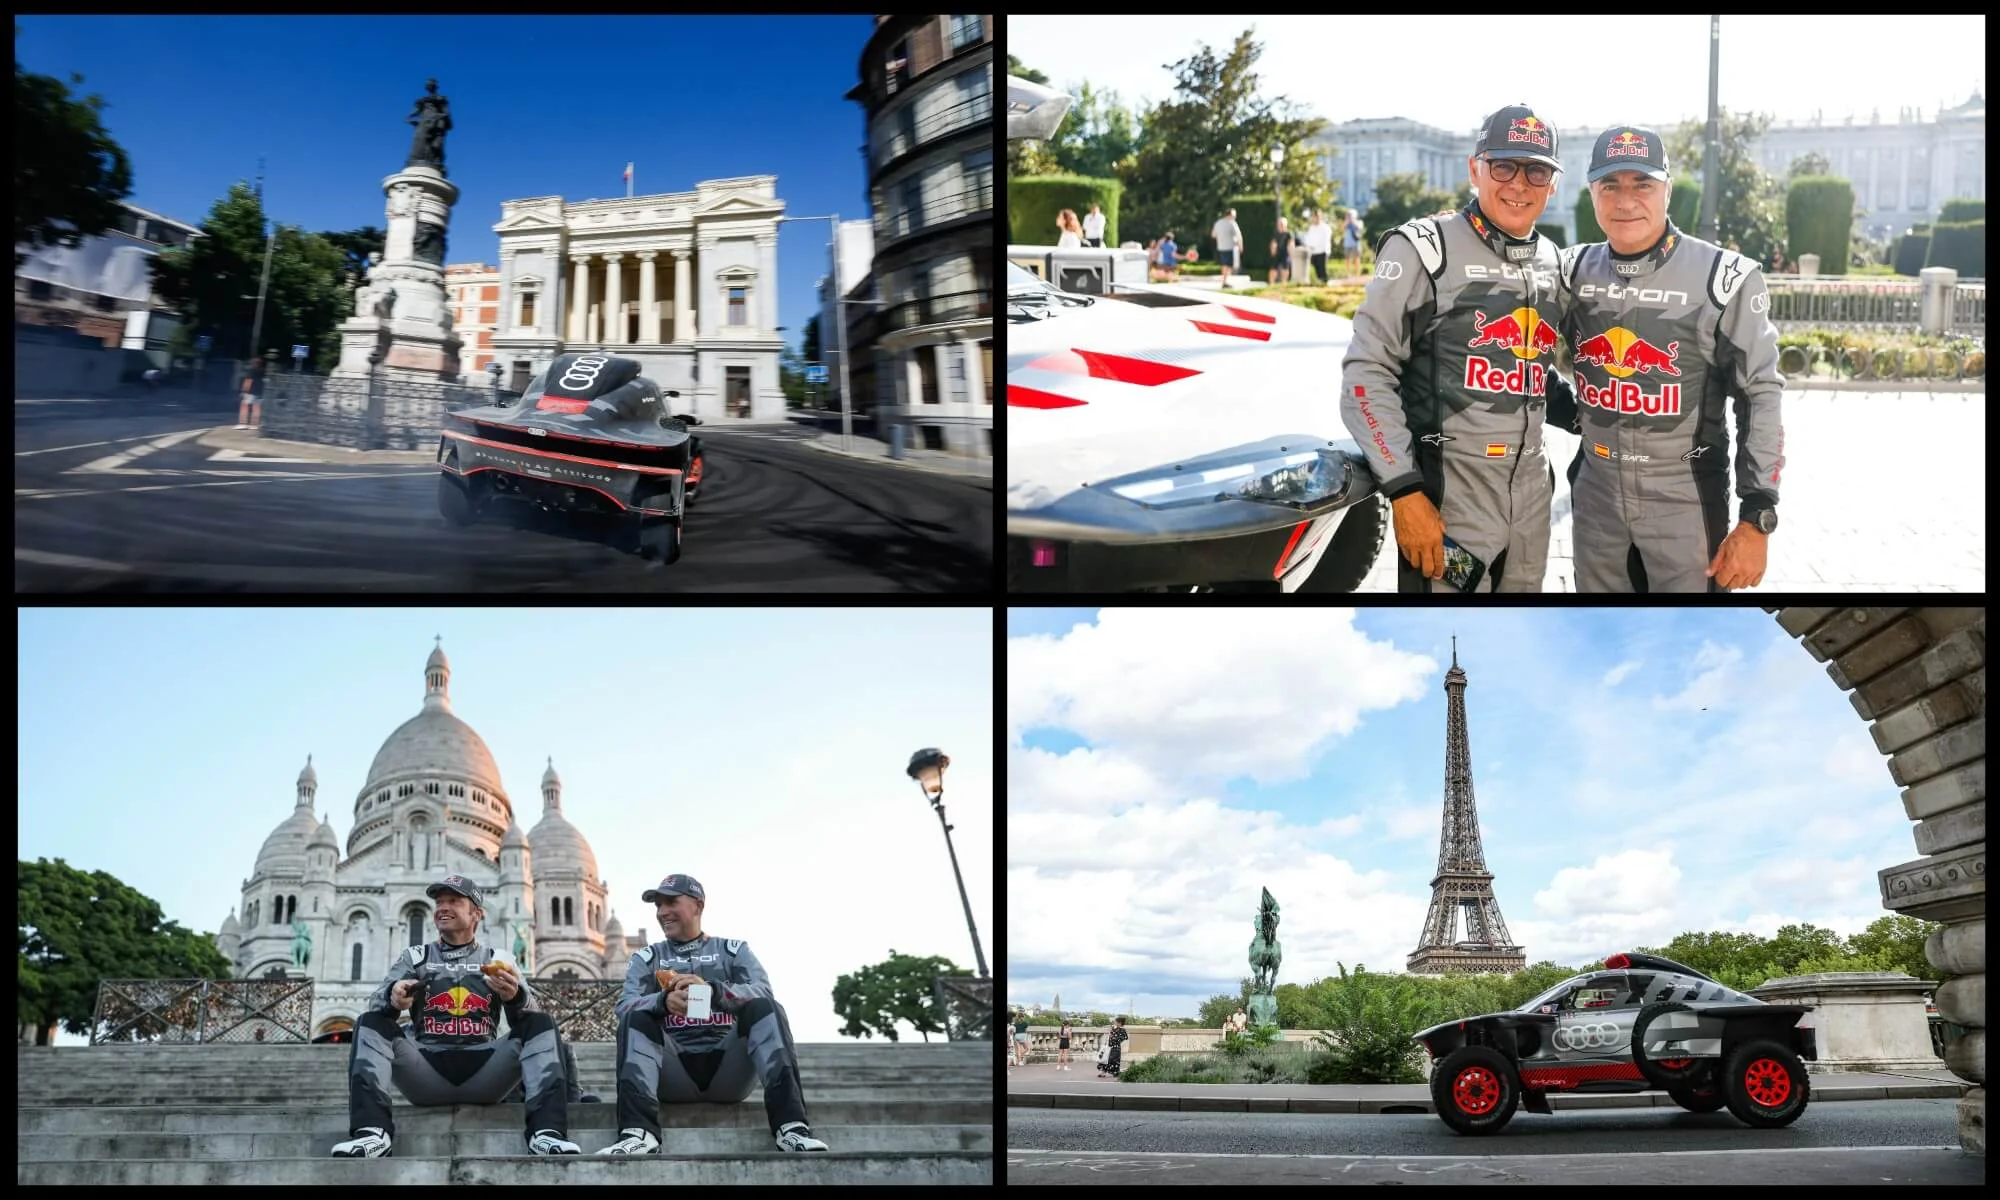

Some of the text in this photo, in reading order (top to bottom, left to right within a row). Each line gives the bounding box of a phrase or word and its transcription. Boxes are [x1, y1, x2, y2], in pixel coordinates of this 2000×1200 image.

[1508, 131, 1550, 147] Red Bull
[1607, 146, 1649, 157] Red Bull
[1579, 282, 1688, 305] e-tron
[1464, 355, 1547, 396] Red Bu
[1576, 371, 1681, 415] Red Bull
[1373, 431, 1396, 466] Sport
[426, 962, 481, 972] e-tro
[424, 1016, 457, 1035] Red
